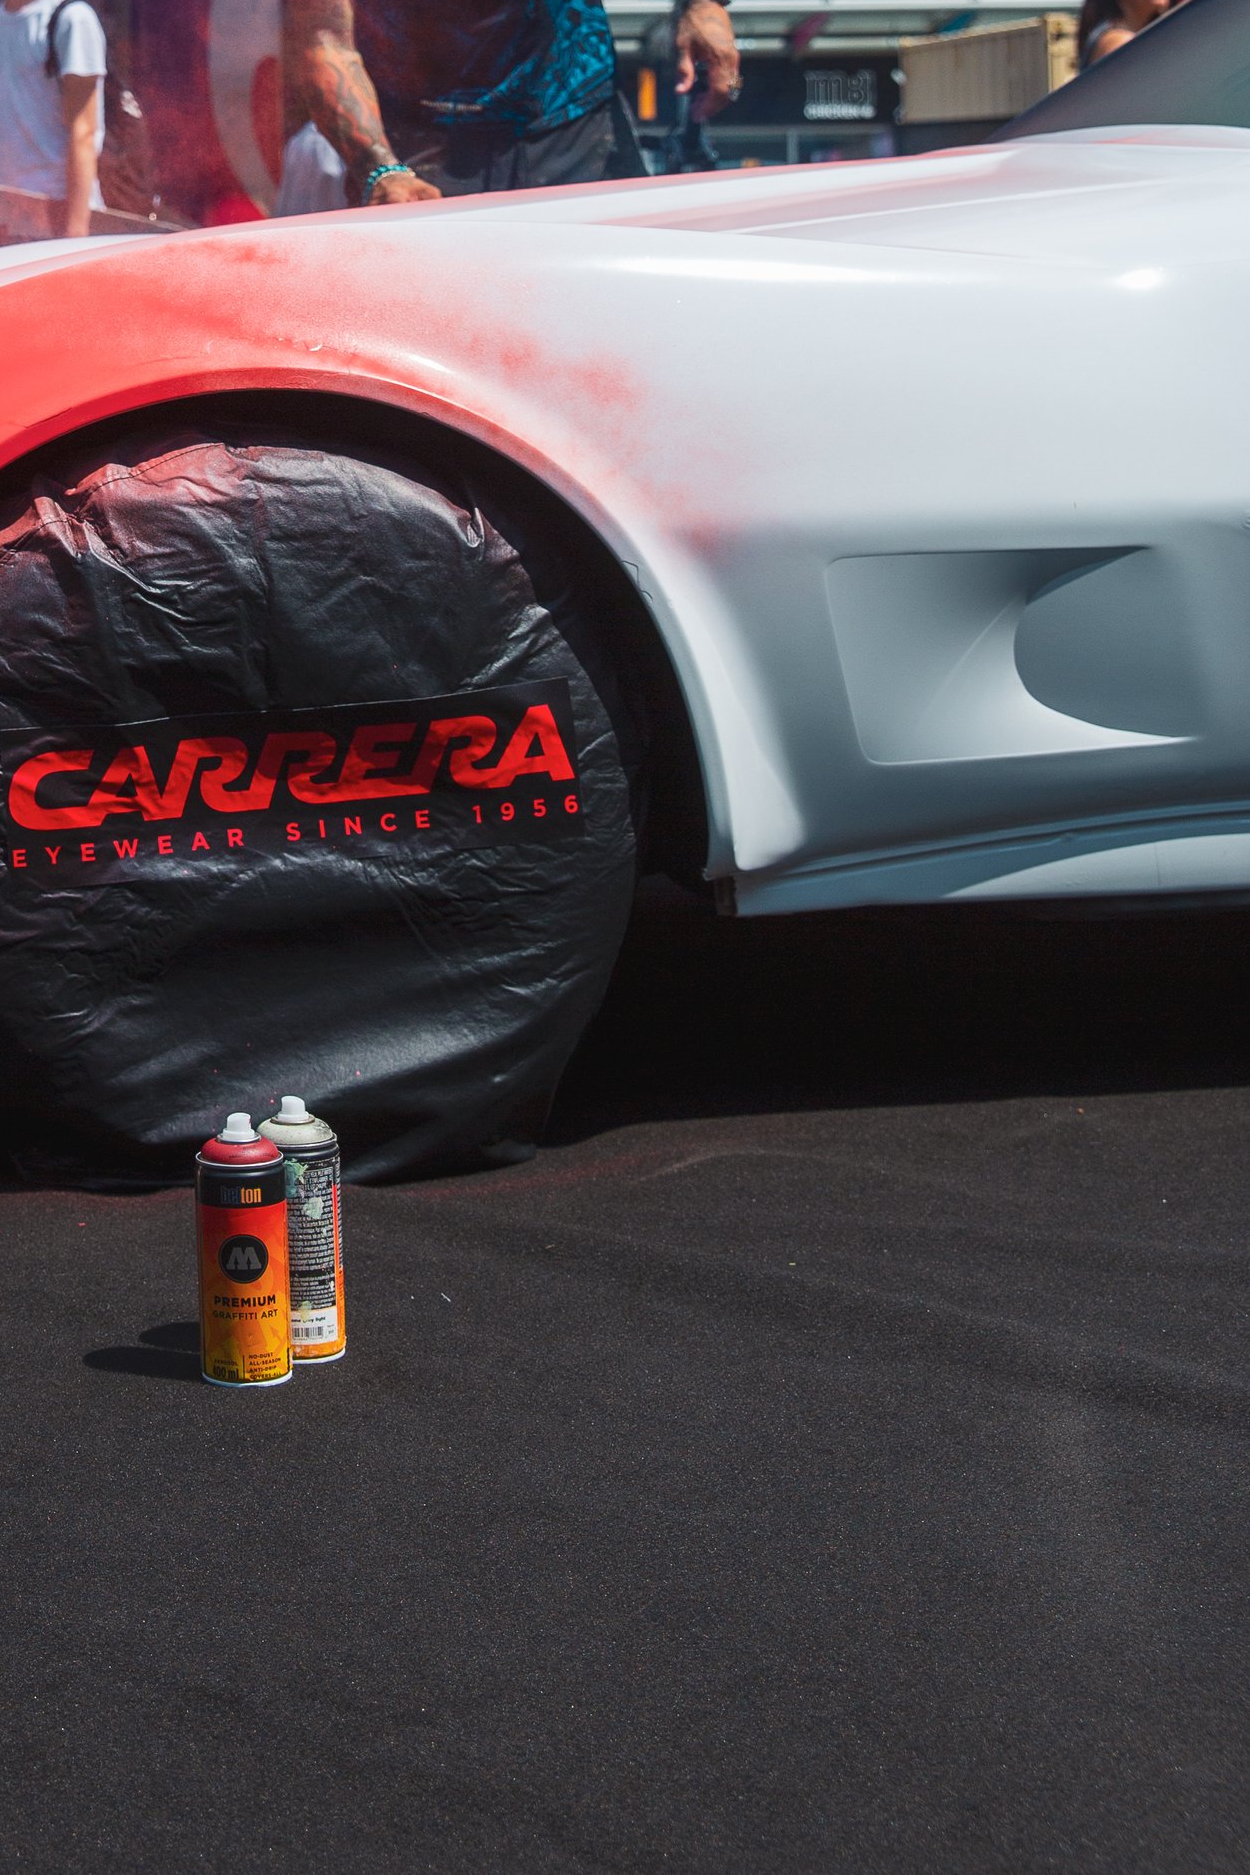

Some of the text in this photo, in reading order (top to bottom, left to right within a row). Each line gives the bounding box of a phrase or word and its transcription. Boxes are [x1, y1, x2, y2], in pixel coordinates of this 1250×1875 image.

[8, 703, 576, 831] CARRERA
[12, 794, 579, 869] EYEWEAR SINCE 1956
[213, 1294, 276, 1308] PREMIUM
[212, 1308, 279, 1321] GRAFFITI ART
[249, 1351, 273, 1360] NO-DUST
